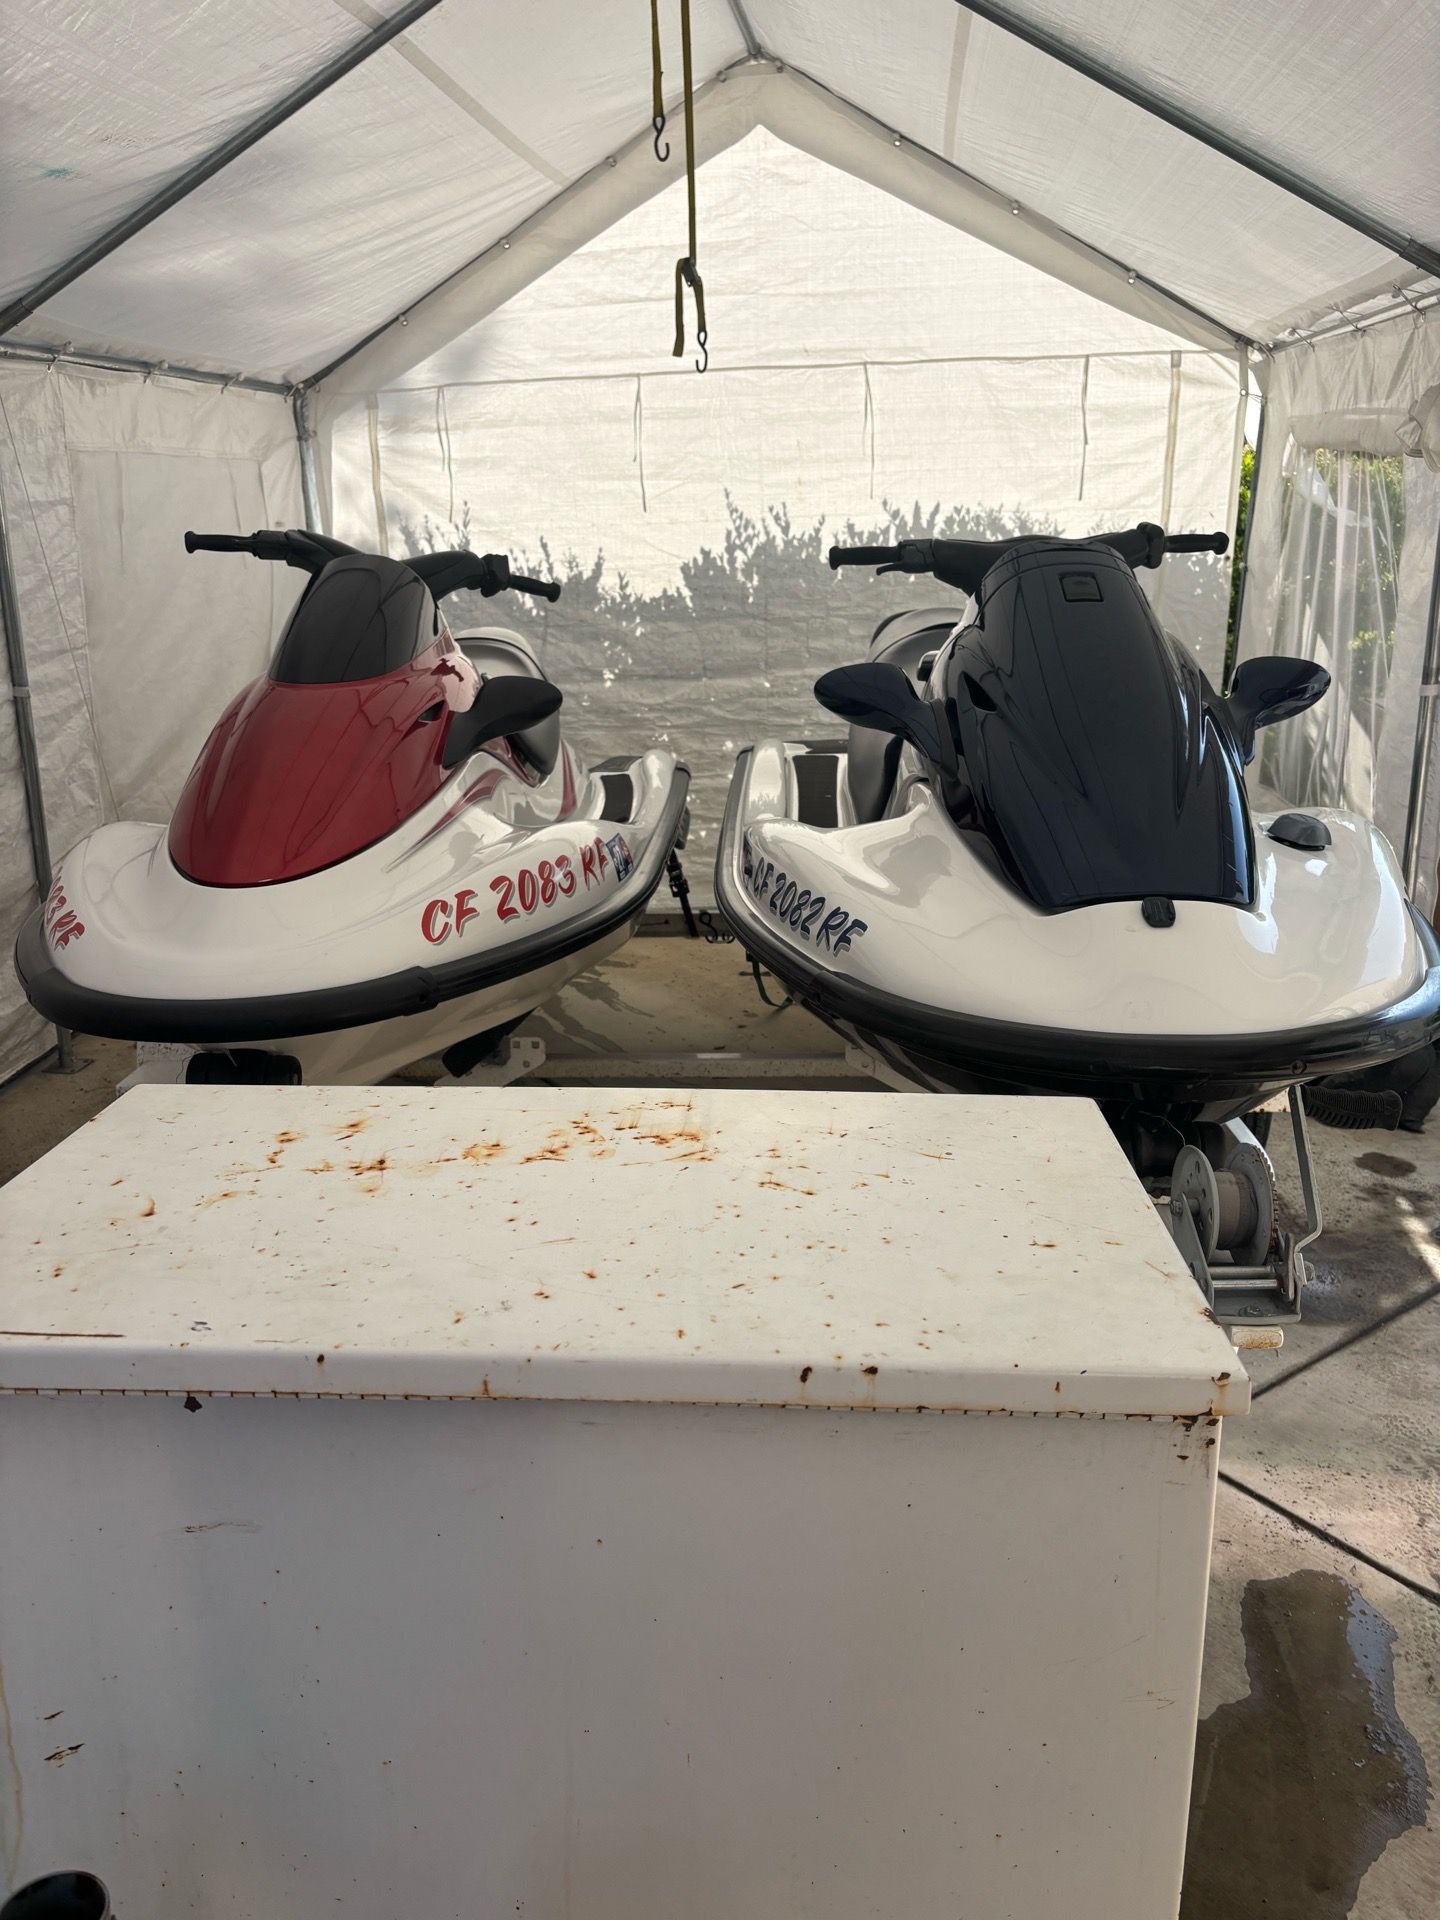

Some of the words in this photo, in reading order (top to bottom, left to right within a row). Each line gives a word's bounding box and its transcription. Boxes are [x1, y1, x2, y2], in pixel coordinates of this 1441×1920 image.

[421, 889, 479, 944] CF
[489, 855, 576, 921] 2083
[579, 837, 609, 891] RF
[754, 857, 774, 898] CF
[770, 872, 826, 940] 2082
[816, 906, 868, 957] RF
